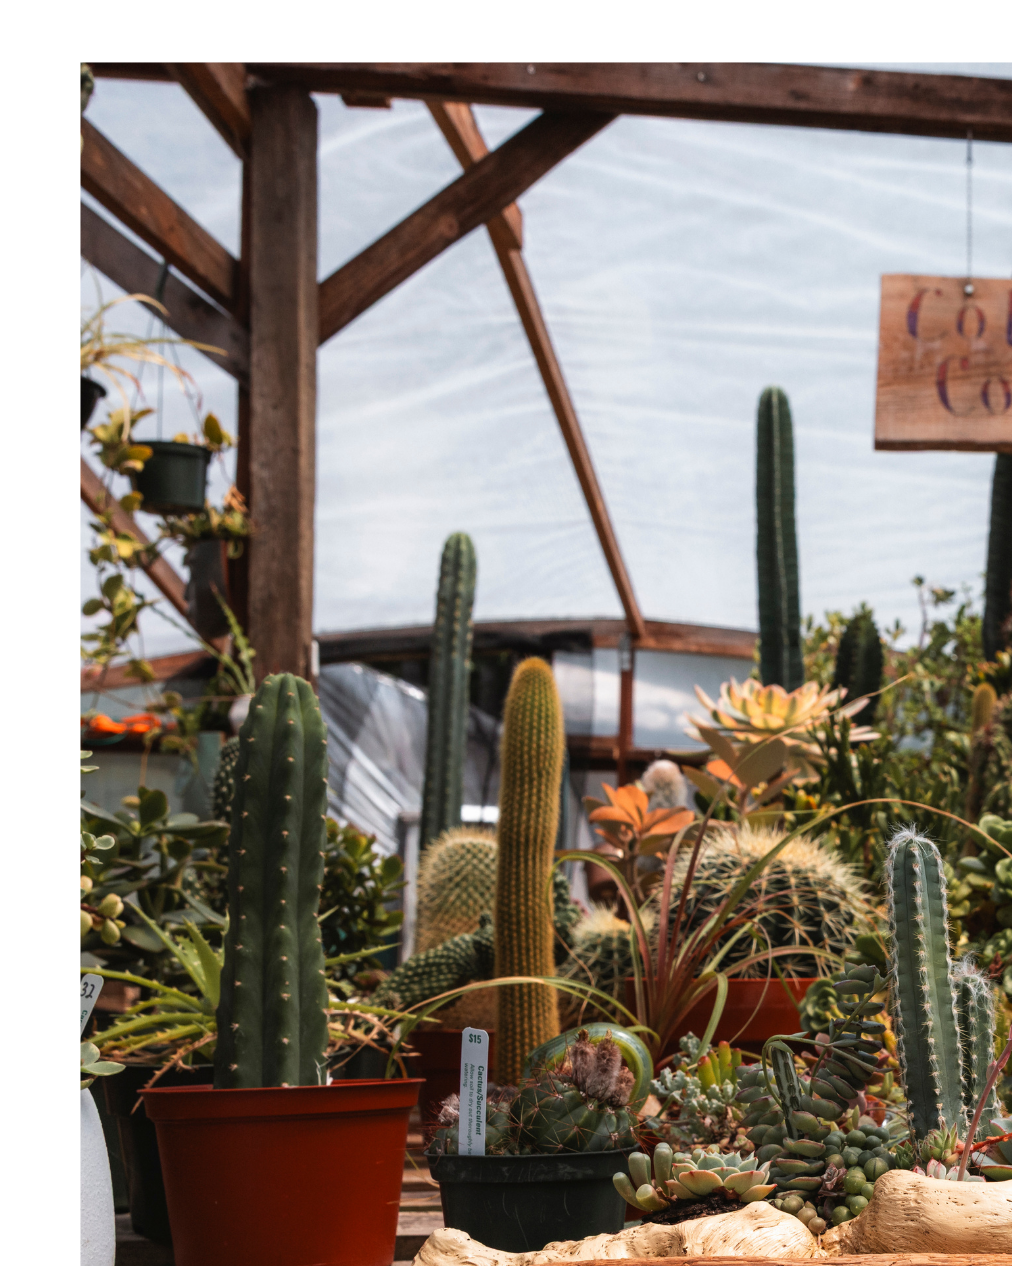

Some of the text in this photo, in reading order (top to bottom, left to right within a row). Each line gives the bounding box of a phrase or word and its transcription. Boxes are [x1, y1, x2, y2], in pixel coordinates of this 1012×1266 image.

[80, 981, 95, 999] 32
[468, 1033, 482, 1044] $15
[475, 1065, 485, 1136] Cactus/Succulent
